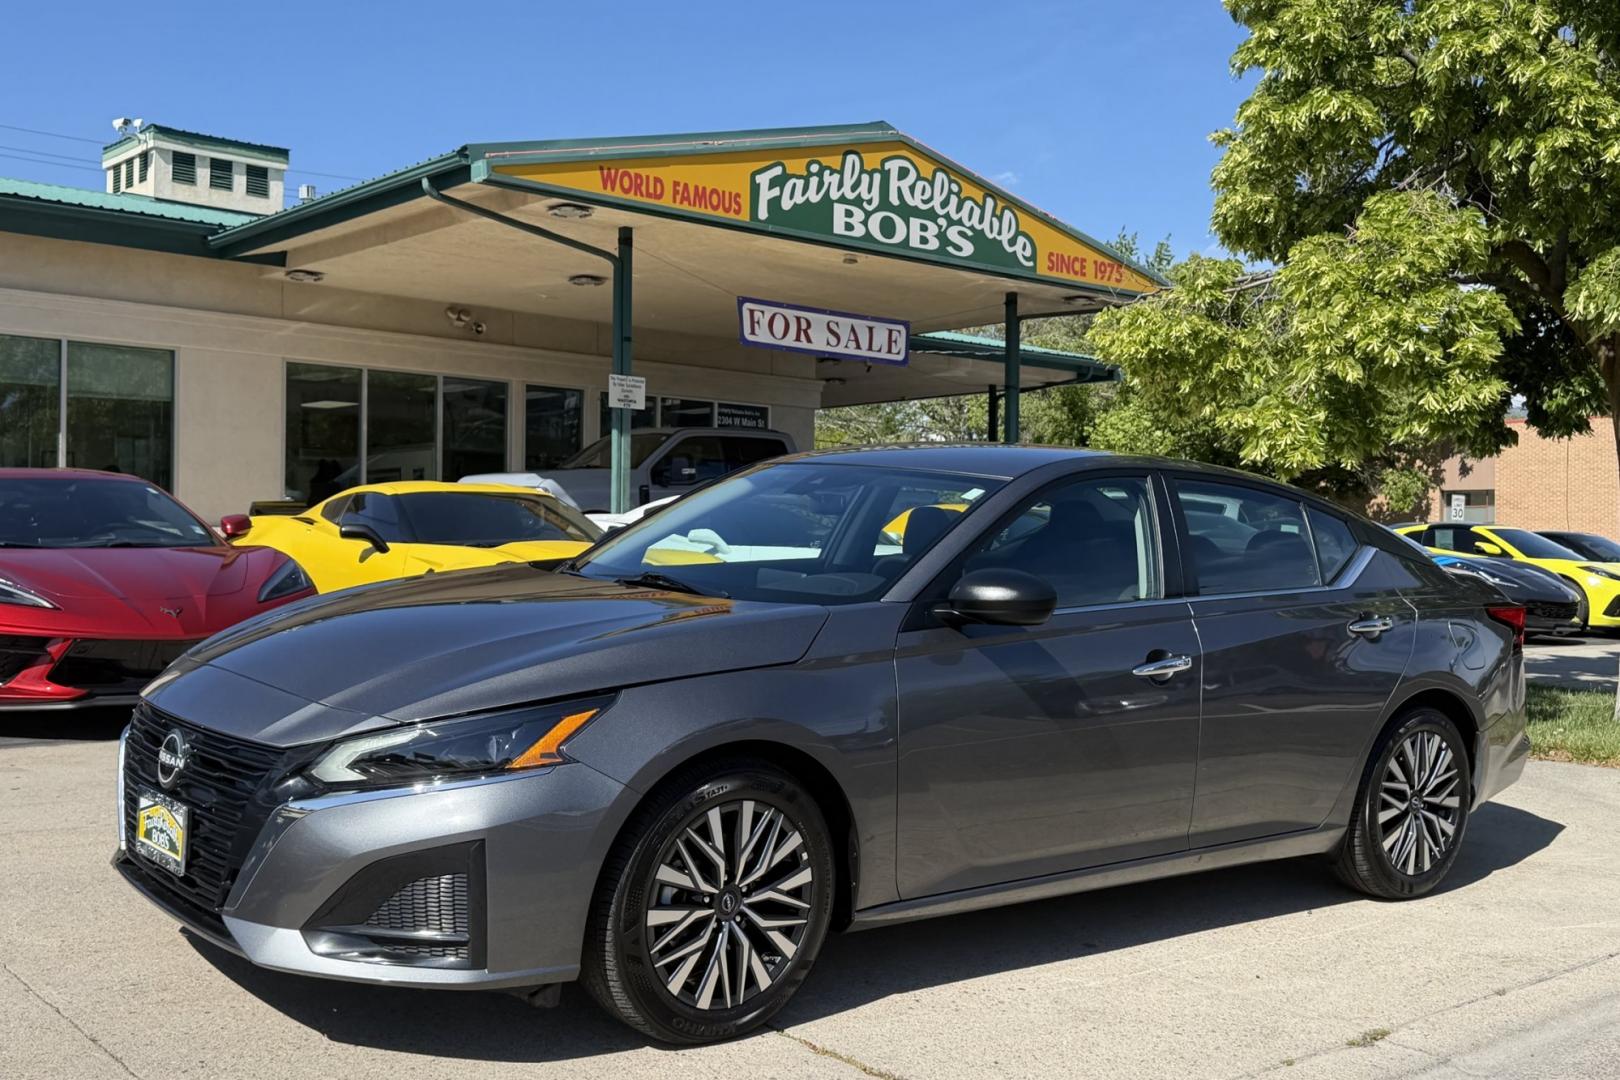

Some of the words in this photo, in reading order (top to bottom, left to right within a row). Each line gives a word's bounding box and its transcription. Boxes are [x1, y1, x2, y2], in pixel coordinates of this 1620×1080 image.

[599, 164, 665, 200] WORLD
[672, 180, 742, 216] FAMOUS
[755, 153, 881, 221] Fairly
[884, 159, 1034, 267] Reliable
[833, 202, 975, 257] BOB'S
[1047, 251, 1087, 278] SINCE
[1093, 259, 1124, 284] 1975
[747, 308, 813, 344] FOR
[826, 320, 902, 356] SALE
[742, 417, 756, 427] Main
[1453, 508, 1464, 518] 30
